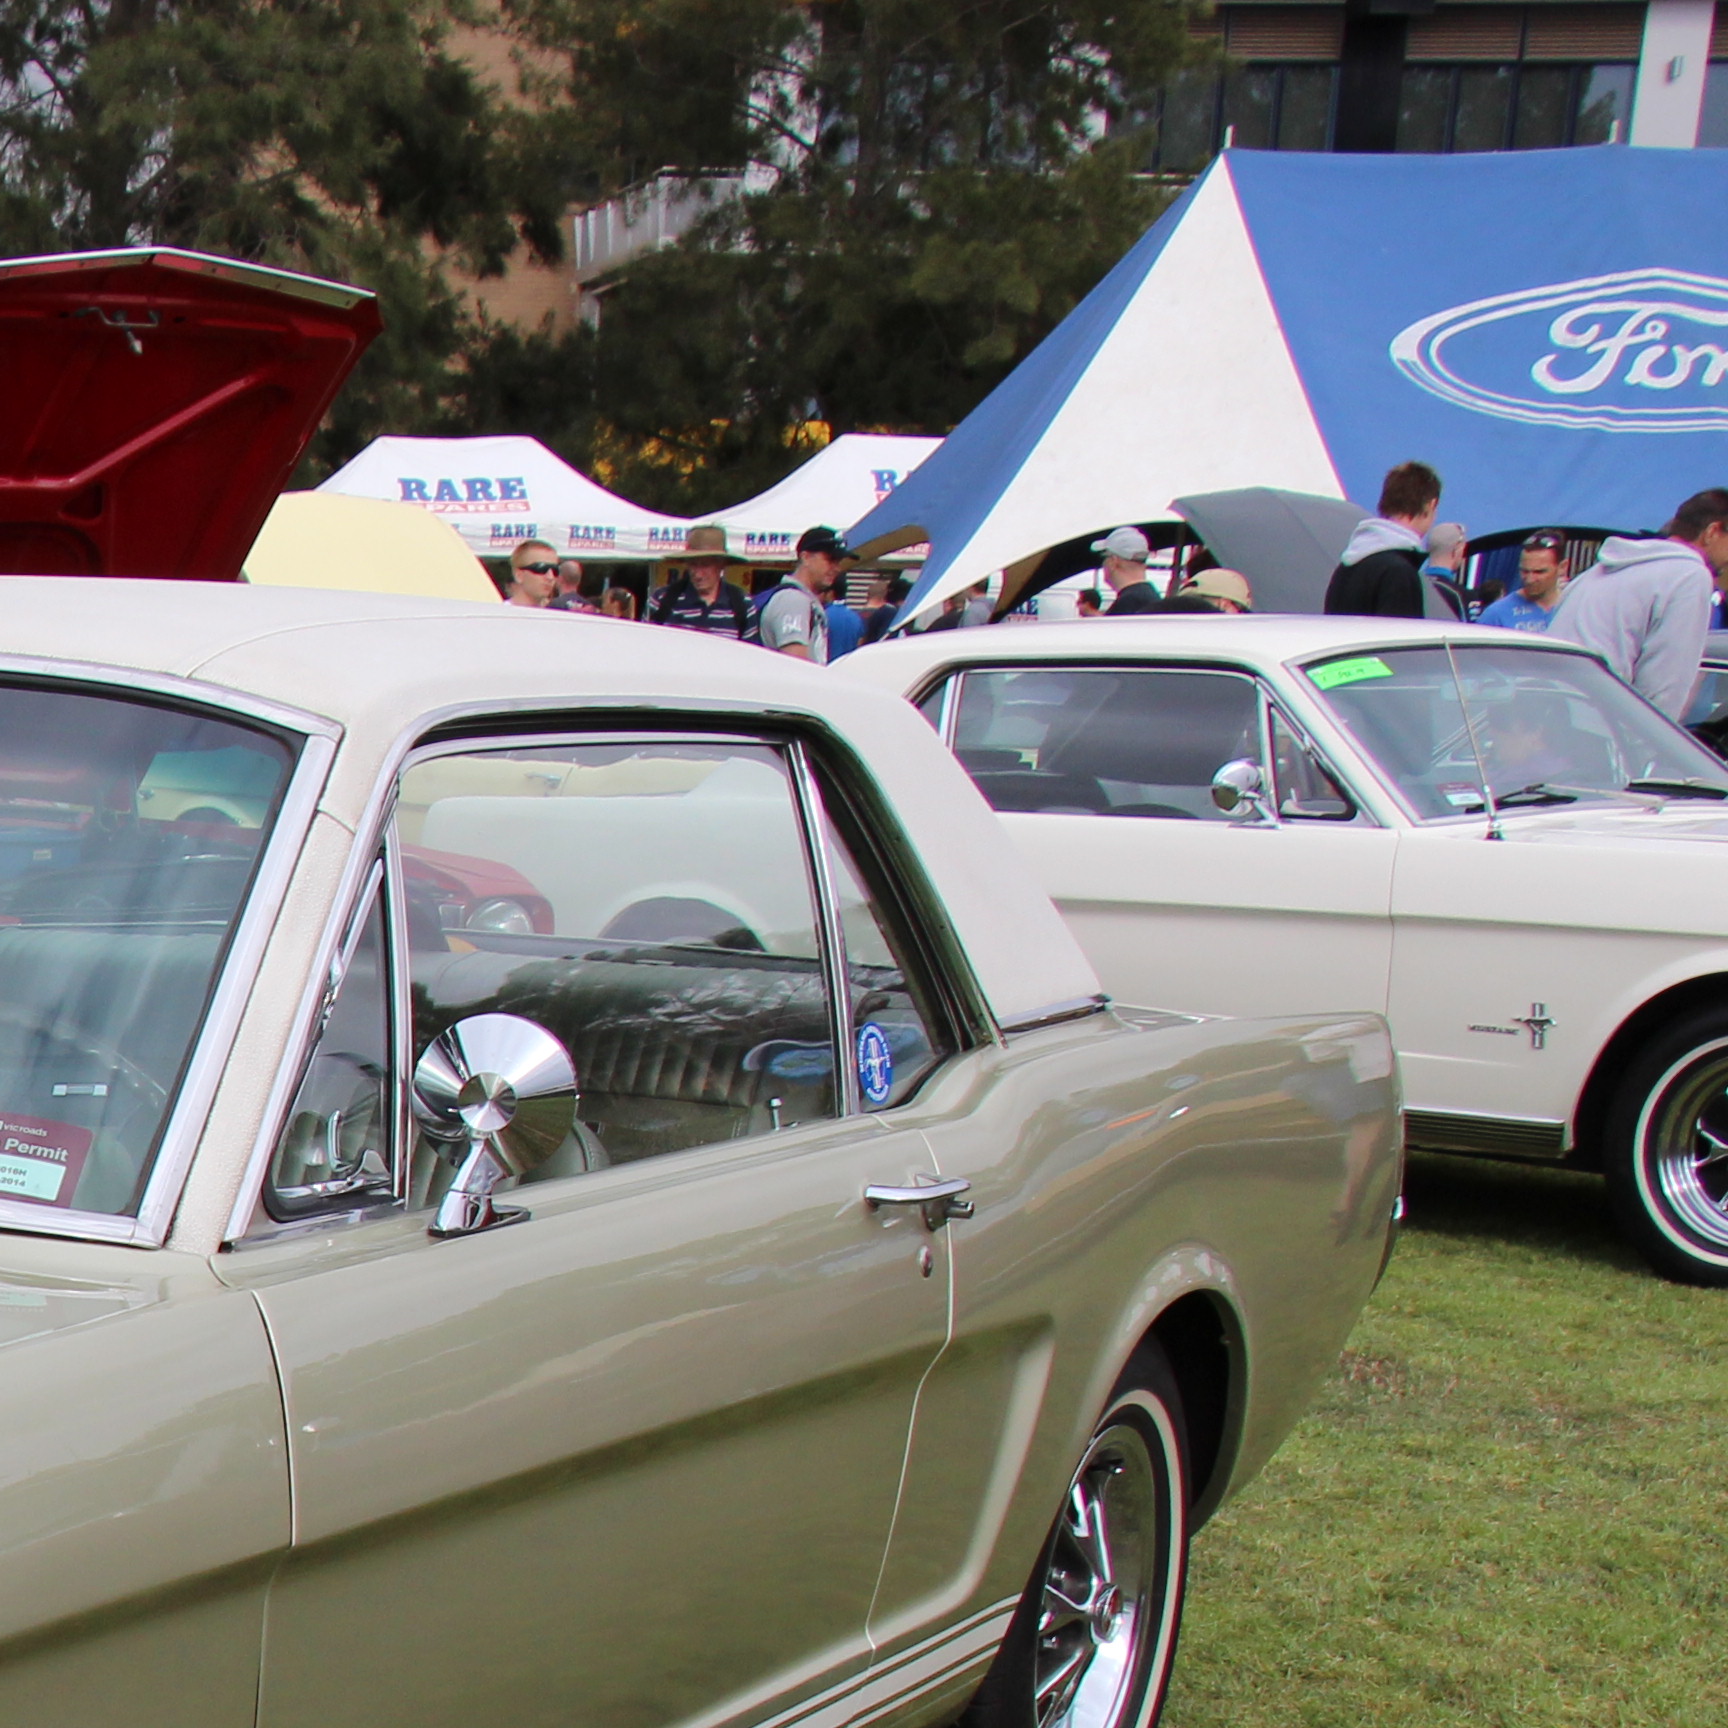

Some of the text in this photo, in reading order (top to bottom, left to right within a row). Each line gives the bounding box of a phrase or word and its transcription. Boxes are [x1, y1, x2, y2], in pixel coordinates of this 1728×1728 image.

[1532, 301, 1728, 392] For
[398, 477, 529, 503] RARE
[425, 502, 529, 513] PARES
[490, 524, 537, 538] RARE
[569, 524, 616, 540] RARE
[746, 532, 792, 545] RARE
[4, 1137, 69, 1162] Permit
